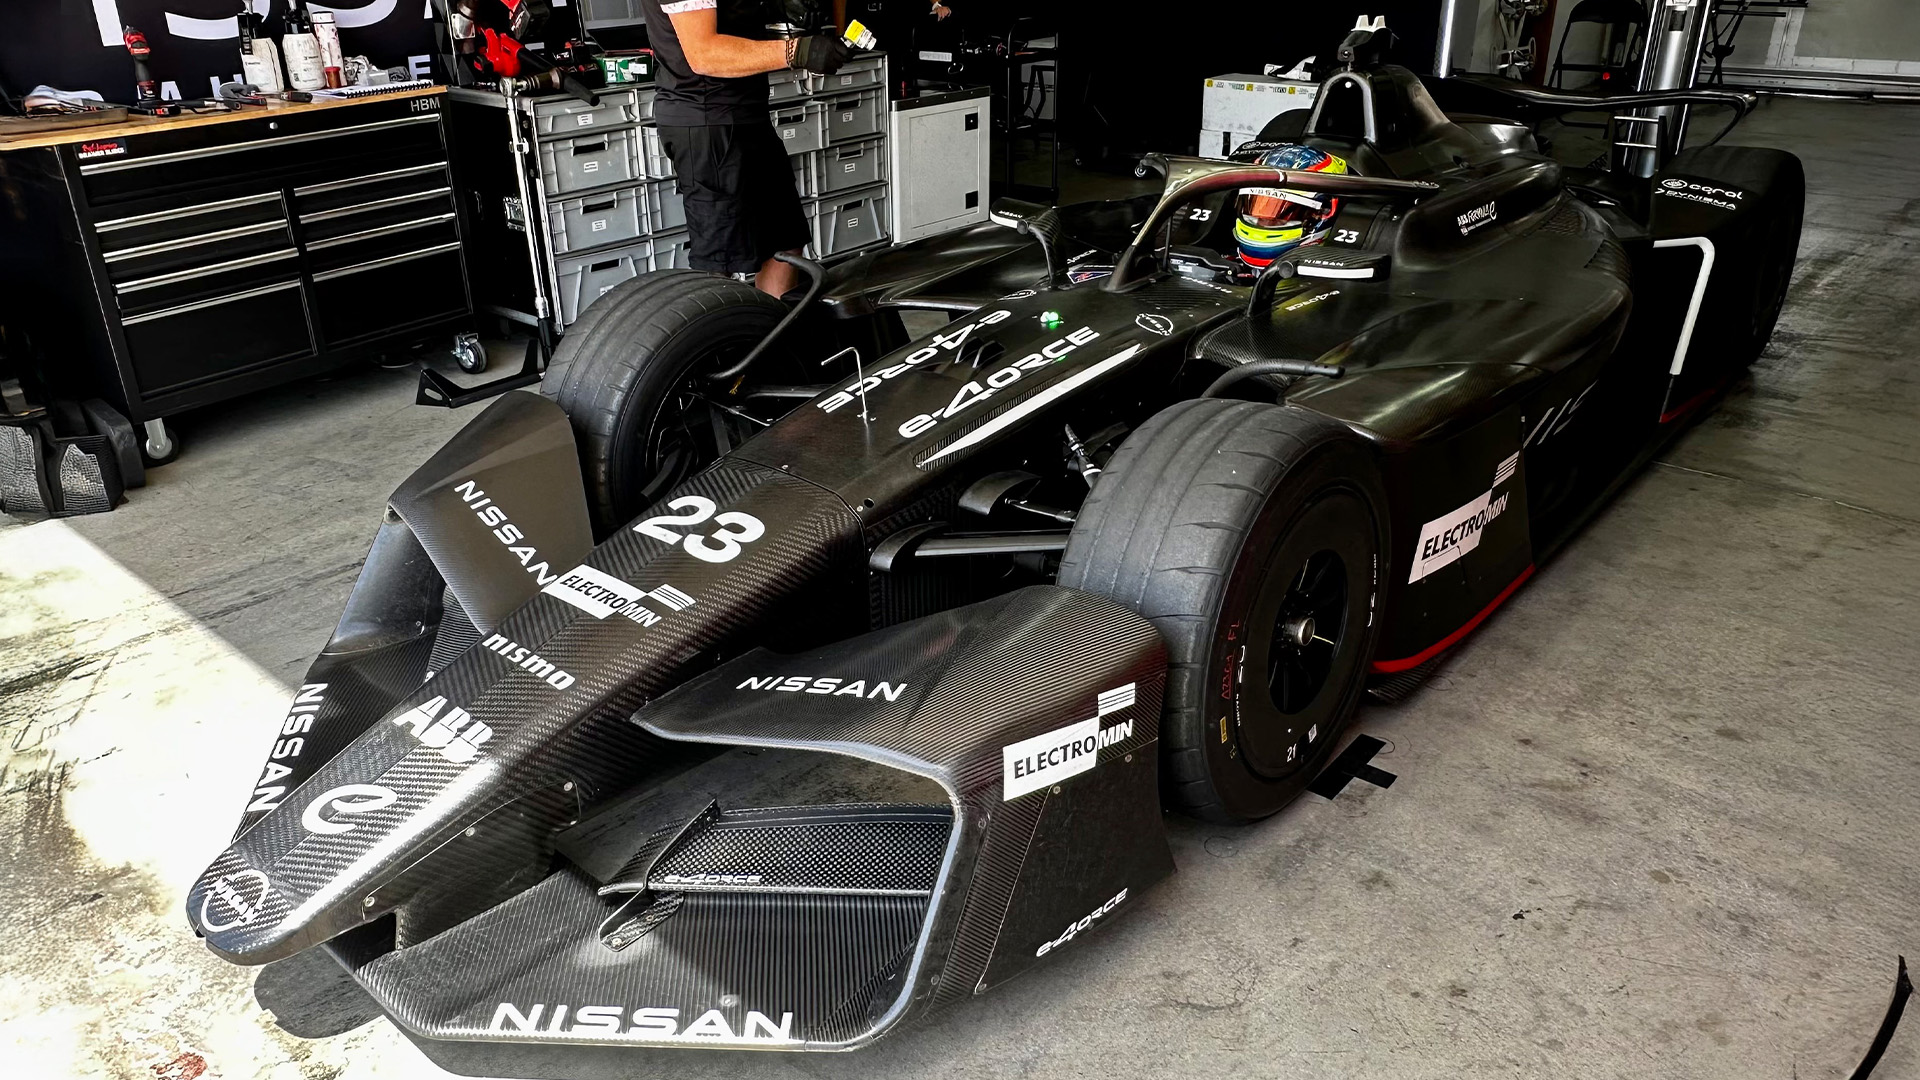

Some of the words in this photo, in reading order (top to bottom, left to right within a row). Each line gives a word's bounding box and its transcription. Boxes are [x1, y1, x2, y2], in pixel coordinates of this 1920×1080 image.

[410, 97, 441, 112] HBM
[1190, 208, 1212, 222] 23
[1333, 229, 1360, 244] 23
[1304, 259, 1344, 267] NISSAN
[454, 479, 558, 587] NISSAN
[632, 495, 766, 564] 23
[1421, 491, 1510, 561] ELECTROMIN
[559, 574, 662, 629] ELECTROMIN
[482, 632, 576, 691] nismo
[736, 675, 908, 702] NISSAN
[246, 682, 329, 813] NISSAN
[392, 695, 493, 763] ABB
[1013, 718, 1134, 780] ELECTROMIN
[488, 1002, 794, 1044] NISSAN
